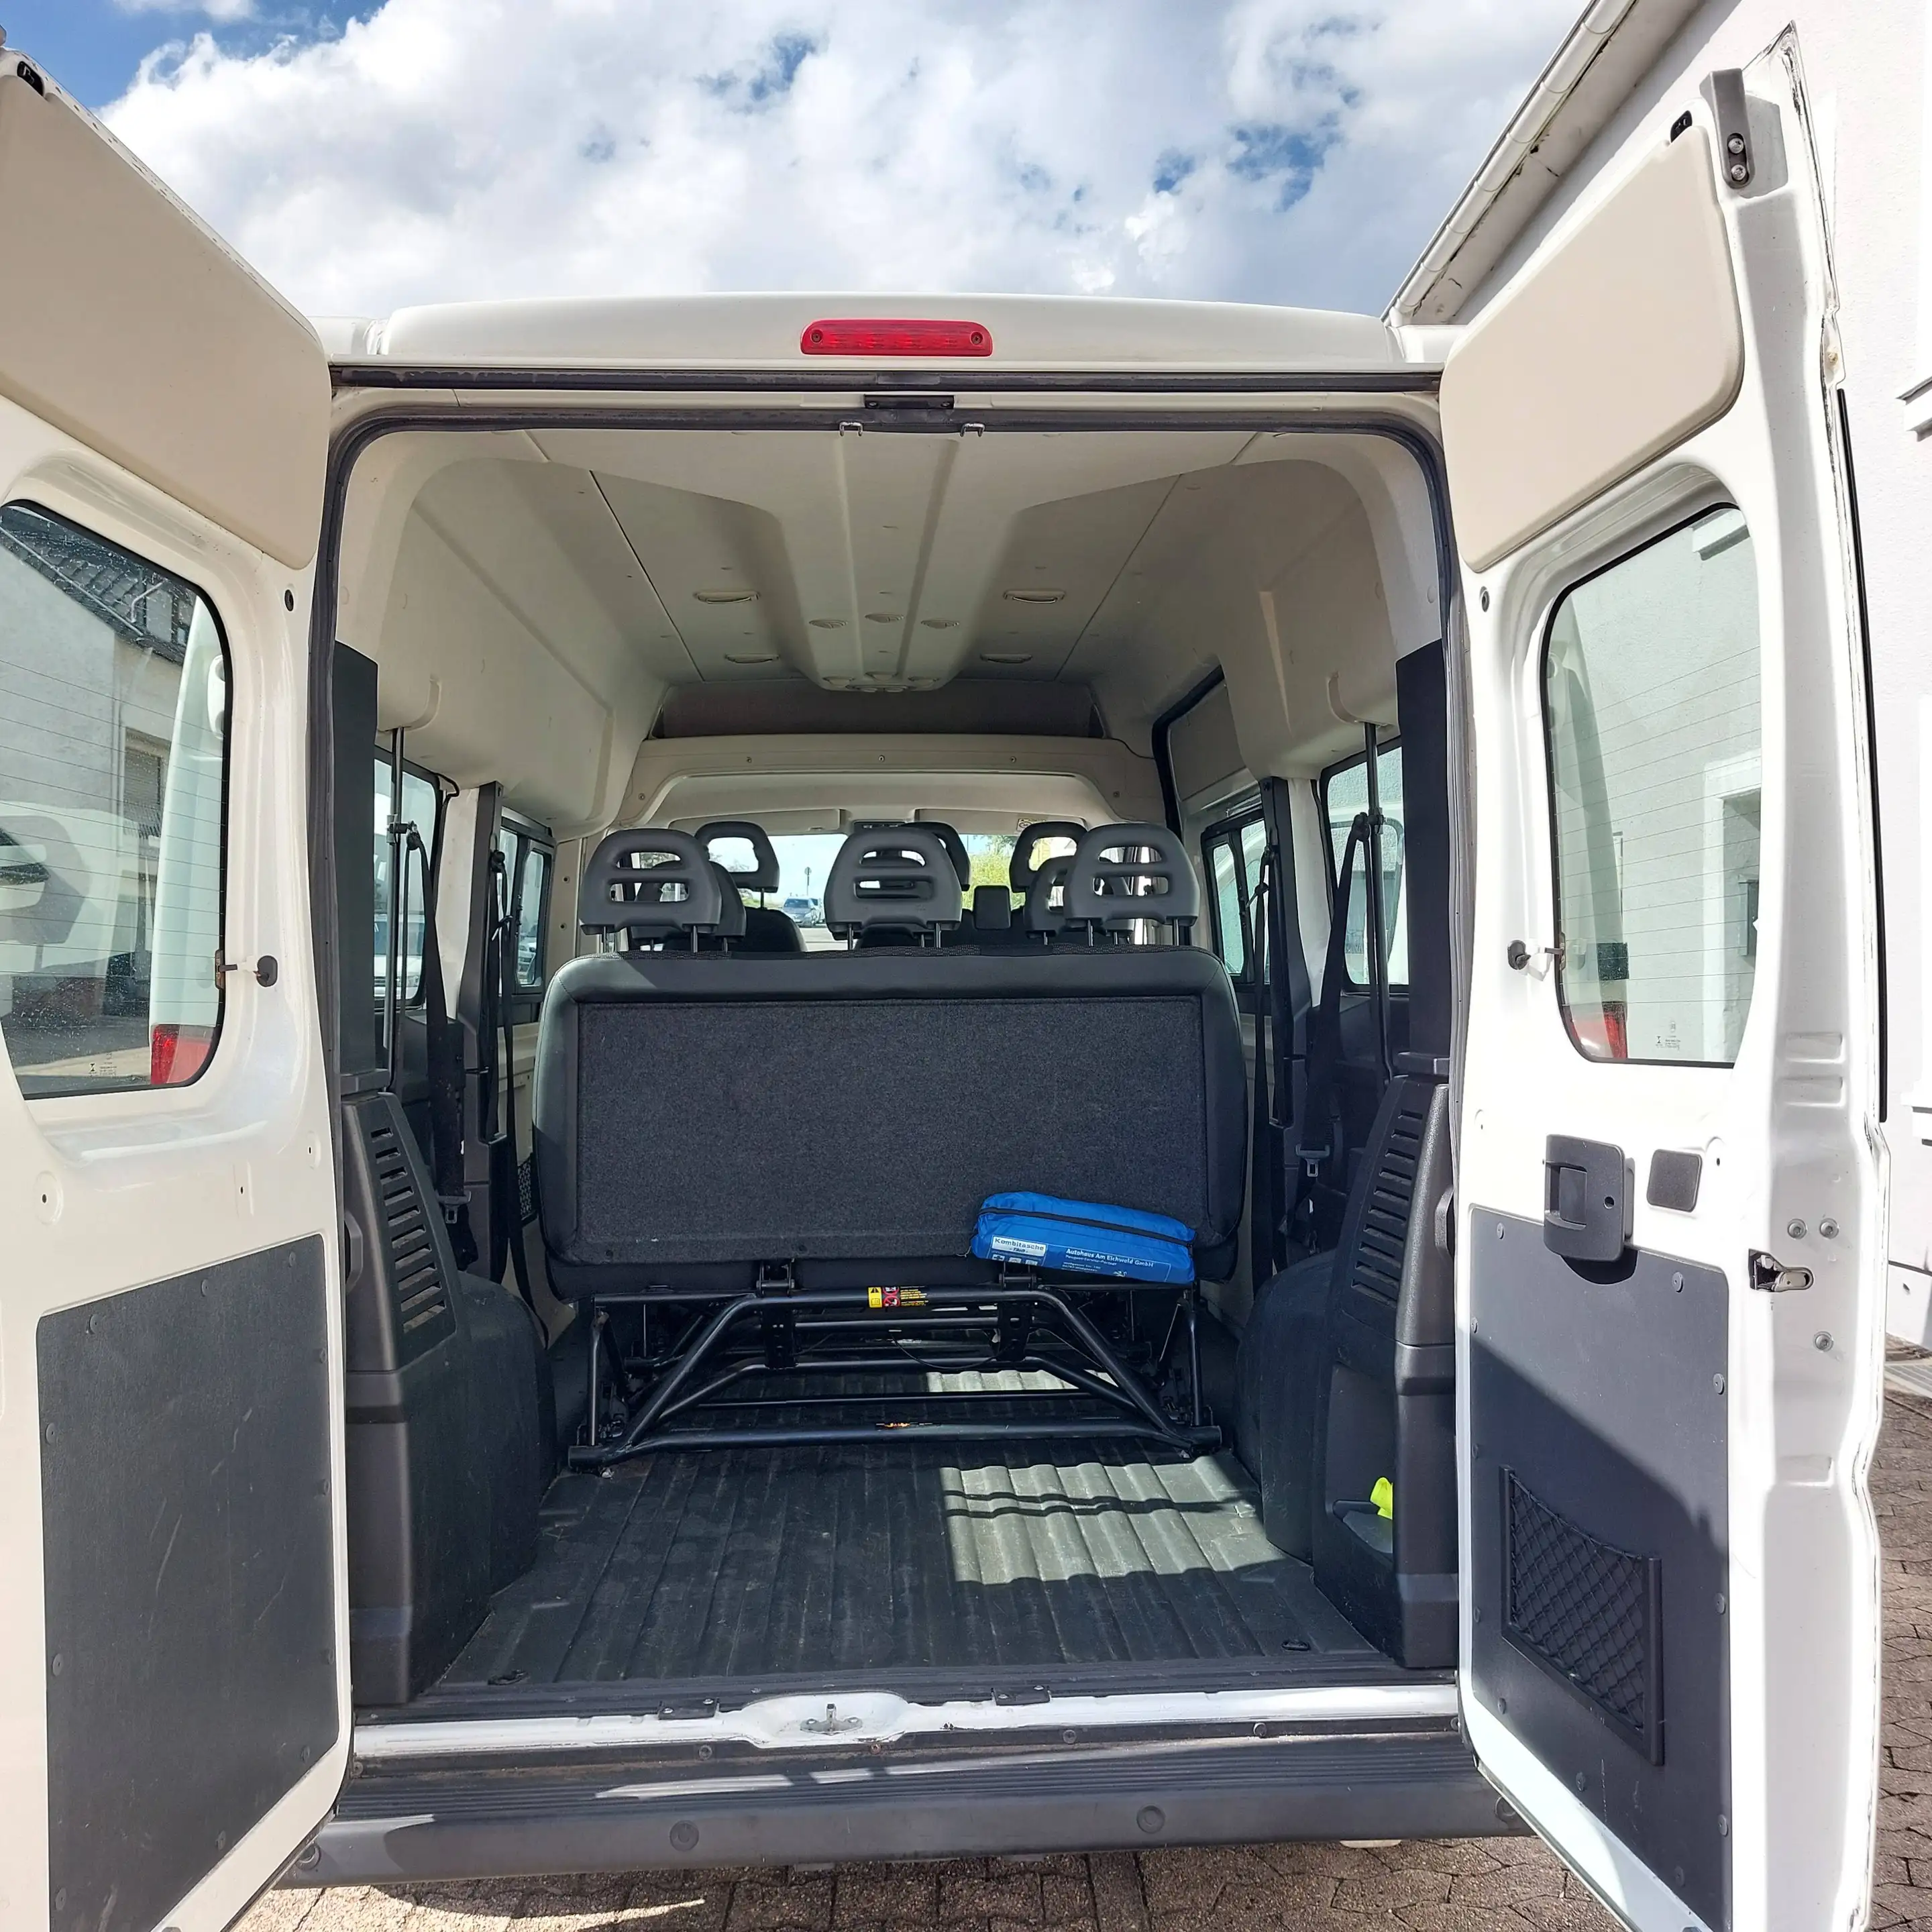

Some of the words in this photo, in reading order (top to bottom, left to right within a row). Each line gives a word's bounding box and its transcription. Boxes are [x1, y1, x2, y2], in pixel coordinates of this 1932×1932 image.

[995, 1238, 1044, 1251] Kombitasche
[1065, 1248, 1094, 1258] Autohaus
[1134, 1260, 1154, 1268] GmbH
